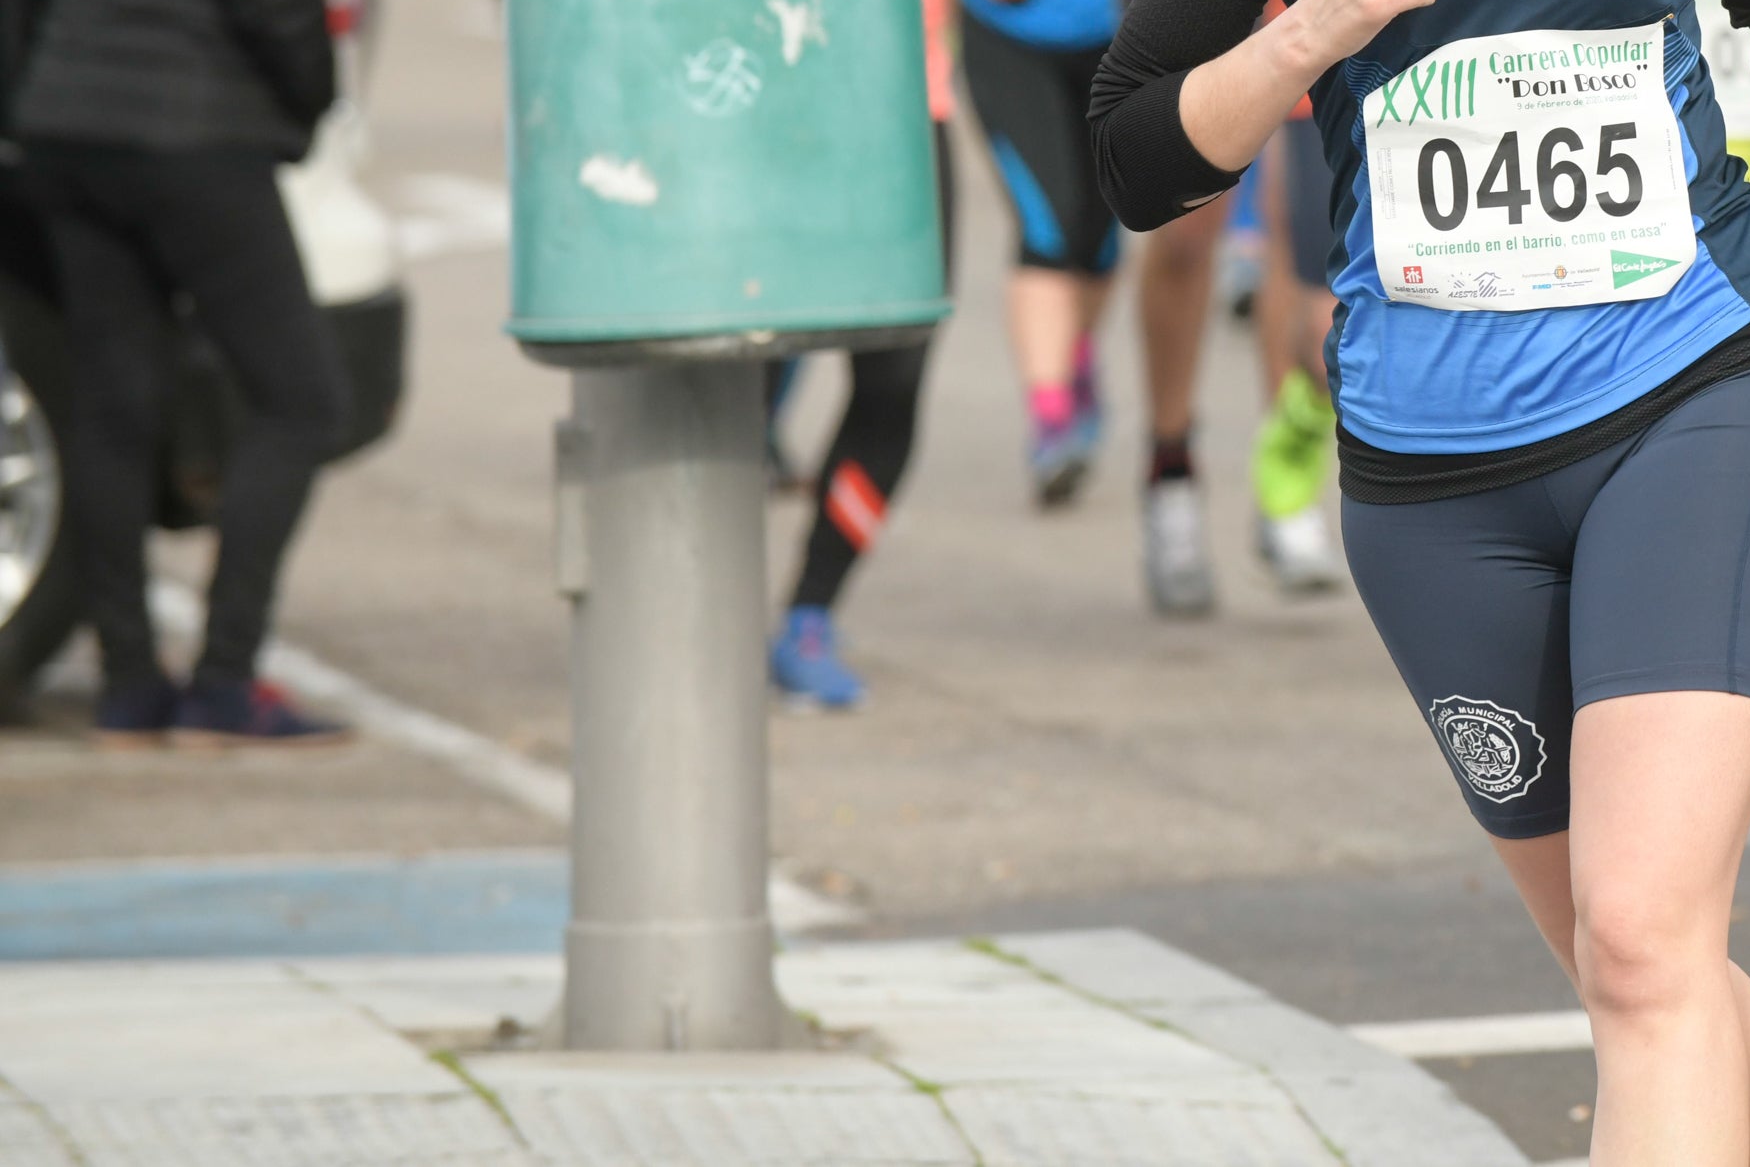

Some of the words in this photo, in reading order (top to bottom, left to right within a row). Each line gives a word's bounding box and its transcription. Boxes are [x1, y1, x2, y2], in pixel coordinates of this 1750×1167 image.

[1376, 57, 1477, 128] XXIII
[1489, 49, 1570, 75] Carrera
[1573, 40, 1653, 69] Popular
[1497, 77, 1566, 98] "Don
[1574, 64, 1648, 93] Bosco"
[1517, 102, 1523, 110] 9
[1524, 102, 1535, 110] de
[1537, 98, 1571, 109] febrero
[1573, 98, 1584, 106] de
[1417, 121, 1643, 231] 0465
[1407, 239, 1480, 257] “Corriendo
[1485, 239, 1501, 253] en
[1506, 237, 1518, 251] el
[1522, 234, 1567, 250] barrio,
[1571, 232, 1606, 246] como
[1610, 230, 1626, 243] en
[1394, 286, 1439, 294] salesianos
[1447, 290, 1478, 298] ALESTE
[1458, 706, 1516, 732] MUNICIPAL
[1468, 774, 1522, 793] VALLADOLID
